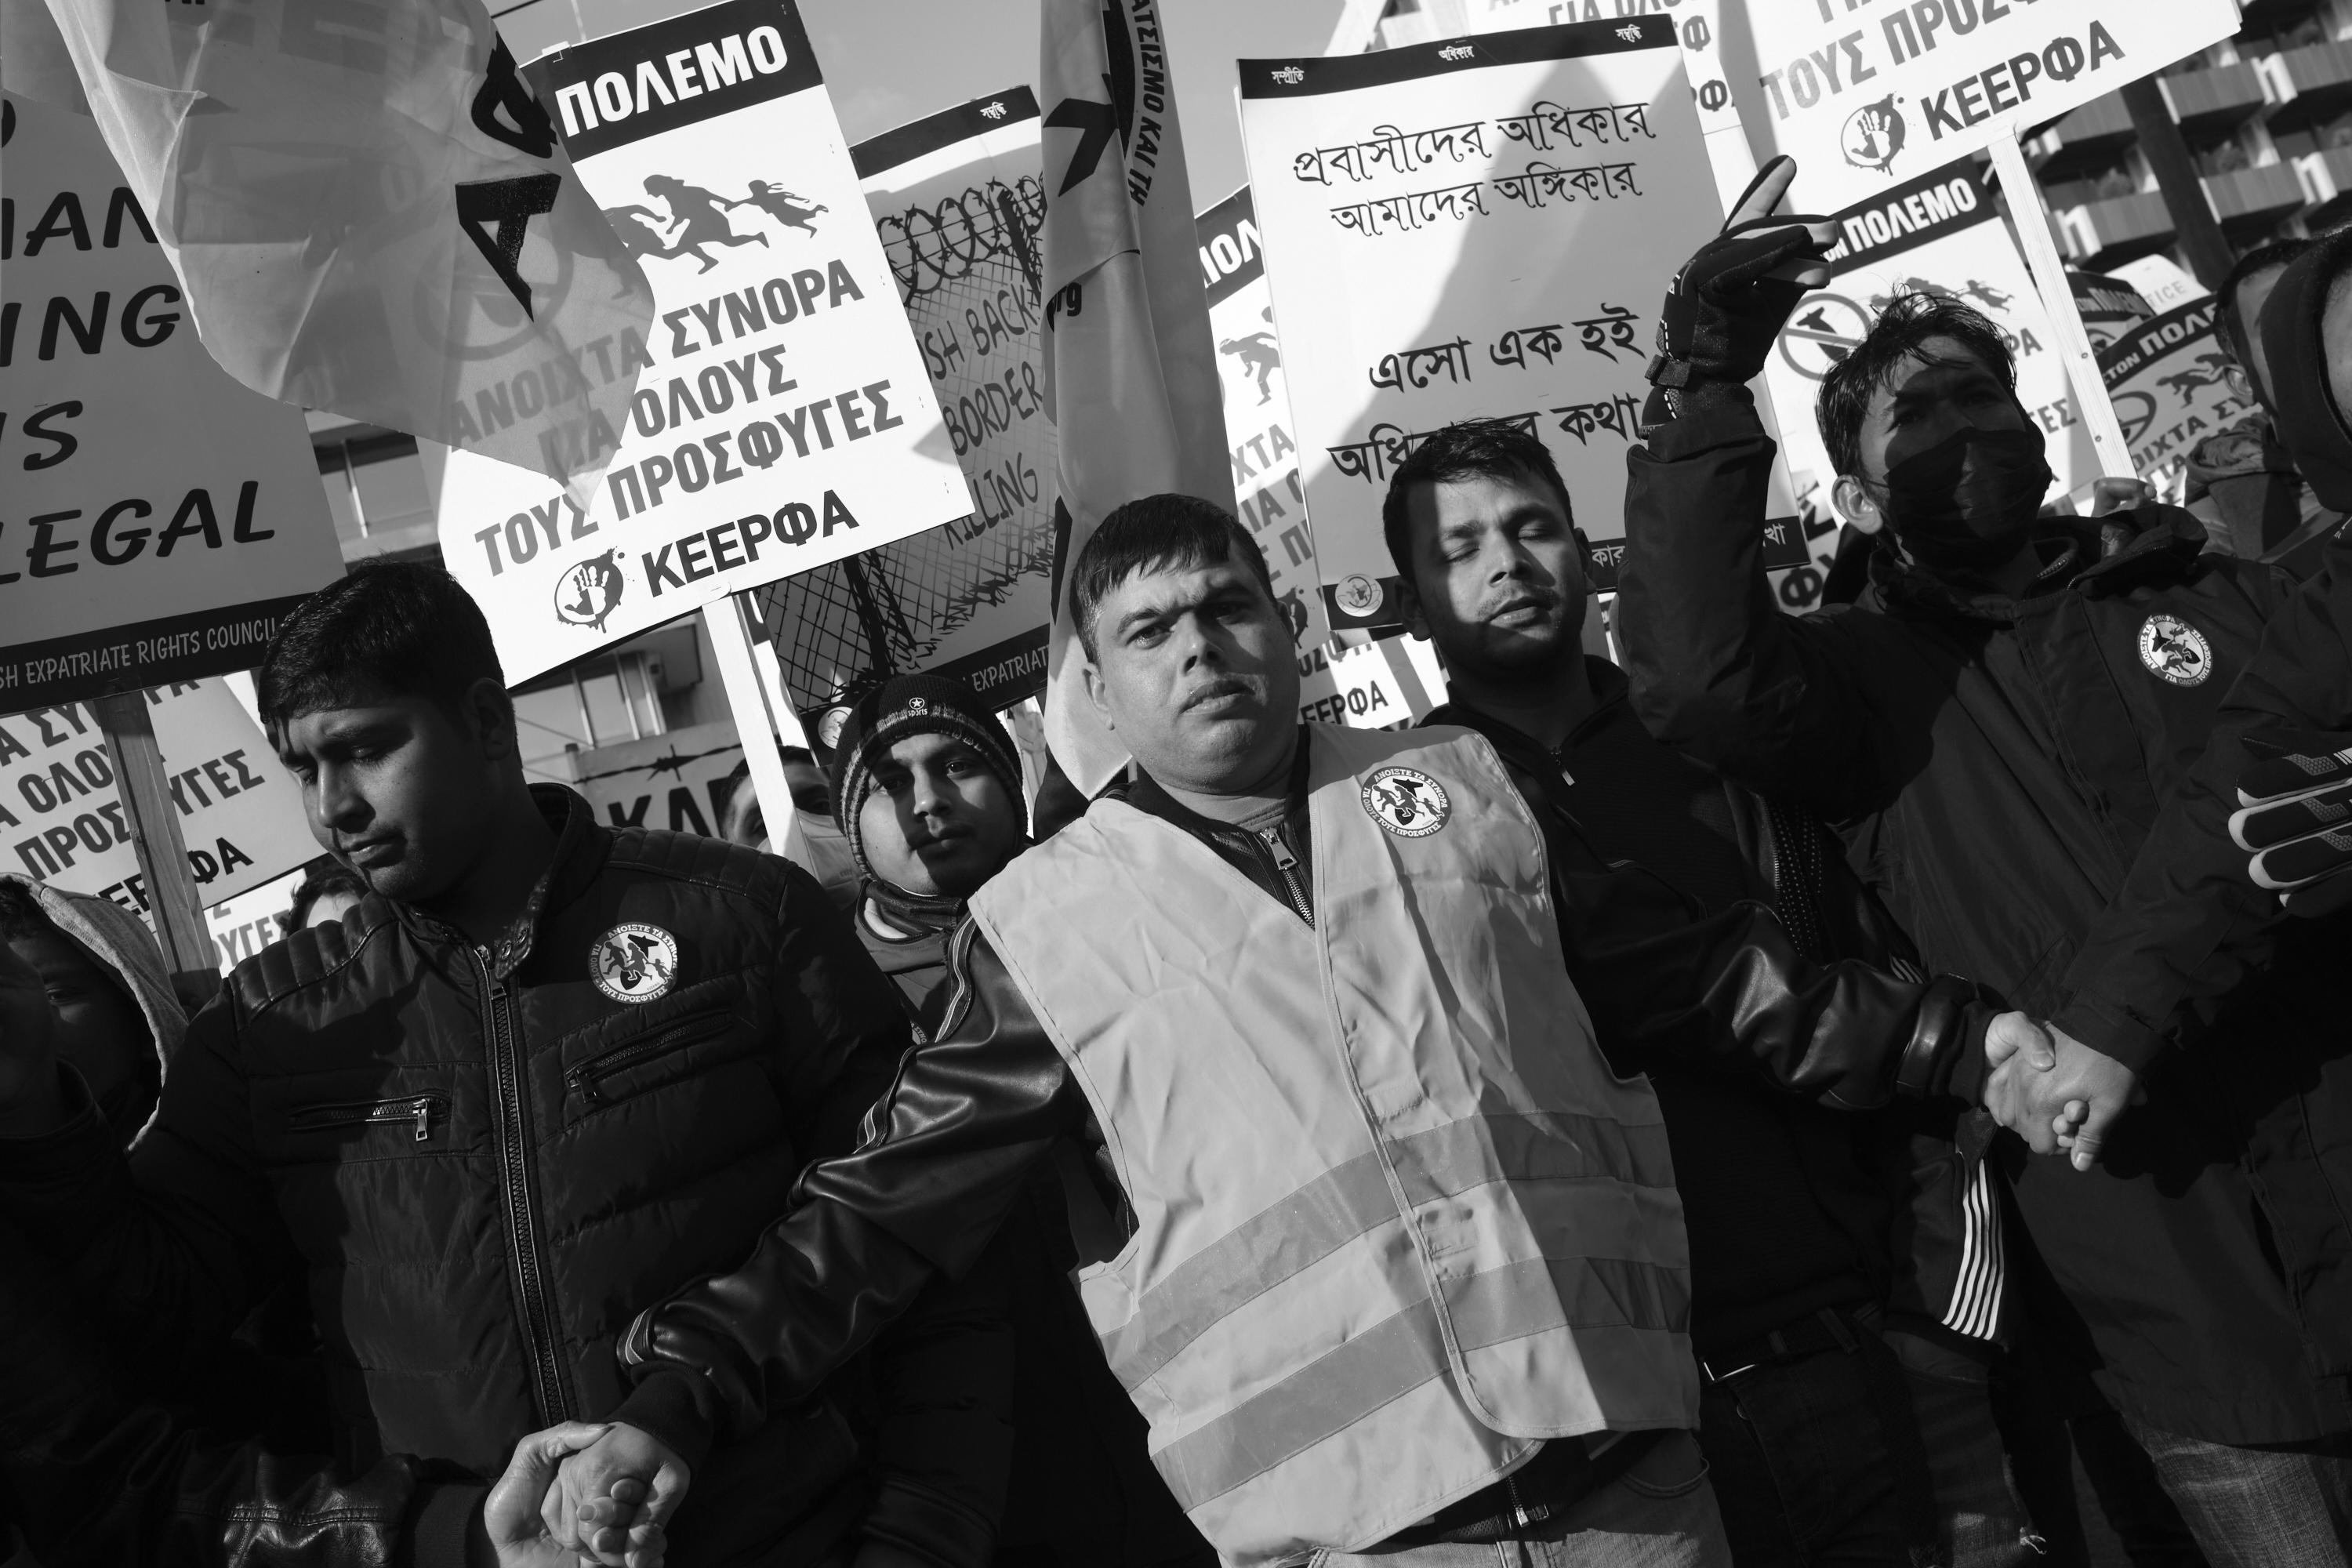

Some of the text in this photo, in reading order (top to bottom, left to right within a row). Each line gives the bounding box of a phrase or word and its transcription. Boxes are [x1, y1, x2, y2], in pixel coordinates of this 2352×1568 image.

[554, 26, 788, 137] ΠΟΛΕΜΟ
[1438, 45, 1475, 61] অধিকার
[1760, 29, 1878, 121] ΤΟΥΣ
[1920, 20, 2125, 141] ΚΕΕΡΦΑ
[1134, 116, 1162, 169] ΚΑΙ
[1294, 100, 1657, 187] প্রবাসীদের অধিকার
[1330, 182, 1490, 237] আমাদের
[1842, 178, 1977, 252] ΠΟΛΕΜΟ
[662, 259, 865, 358] ΣΥΝΟΡΑ
[1369, 303, 1646, 393] এসো এক হই
[630, 344, 798, 438] ΟΛΟΥΣ
[942, 361, 1044, 456] BORDER
[475, 379, 903, 577] ΤΟΥΣ ΠΡΟΣΦΥΓΕΣ
[641, 489, 859, 597] ΚΕΕΡΦΑ
[26, 644, 132, 684] EXPATRIATE
[136, 631, 201, 664] RIGHTS
[908, 708, 928, 717] sports
[1363, 787, 1371, 798] ΓΙΑ
[1377, 817, 1396, 833] ΤΟΥΣ
[1396, 822, 1442, 837] ΠΡΟΣΦΥΓΕΣ
[1374, 768, 1448, 808] ΑΝΟΙΞΤΕ ΤΑ ΣΥΝΟΡΑ
[608, 924, 651, 938] ΑΝΟΙΞΤΕ
[652, 928, 663, 938] ΤΑ
[591, 944, 602, 956] ΓΙΑ
[599, 982, 619, 998] ΤΟΥΣ
[617, 985, 668, 1003] ΠΡΟΣΦΥΓΕΣ
